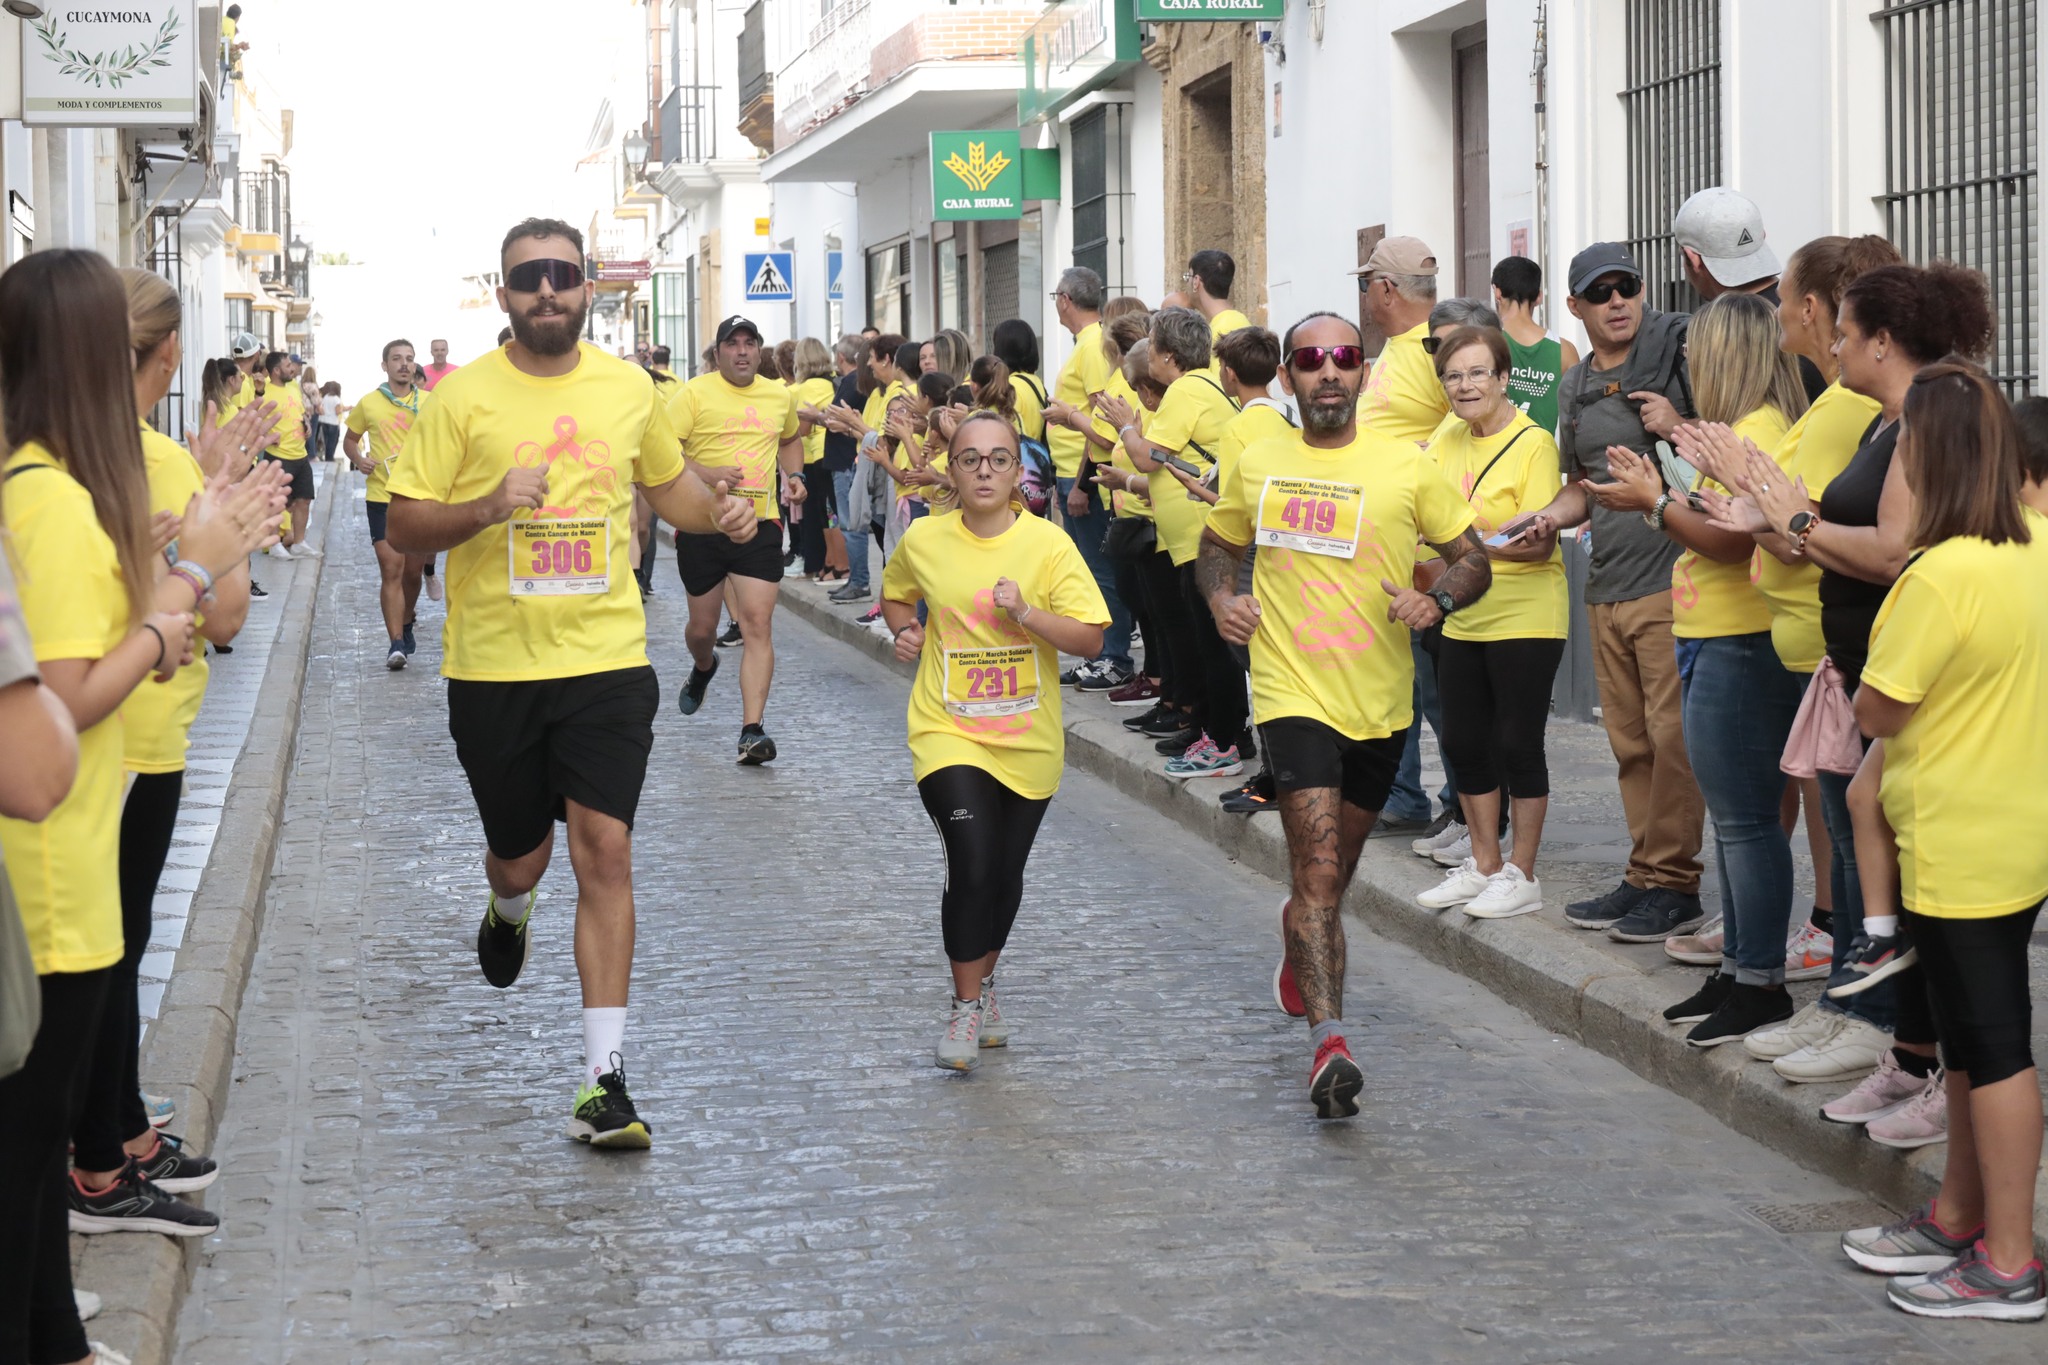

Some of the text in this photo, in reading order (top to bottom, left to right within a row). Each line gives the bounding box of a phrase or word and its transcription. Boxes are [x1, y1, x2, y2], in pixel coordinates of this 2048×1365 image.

[1159, 0, 1264, 9] CAJA RURAL
[66, 11, 153, 24] CUCAYMONA
[57, 101, 162, 109] MODA Y COMPLEMENTOS
[942, 198, 1014, 209] CAJA RURAL
[1511, 366, 1555, 383] ncluye
[1281, 480, 1302, 488] Carrera
[1308, 482, 1331, 491] Marcha
[1333, 485, 1360, 495] Solidaria
[1330, 492, 1349, 500] Mama
[1281, 496, 1337, 533] 419
[531, 539, 592, 574] 306
[966, 665, 1018, 698] 231
